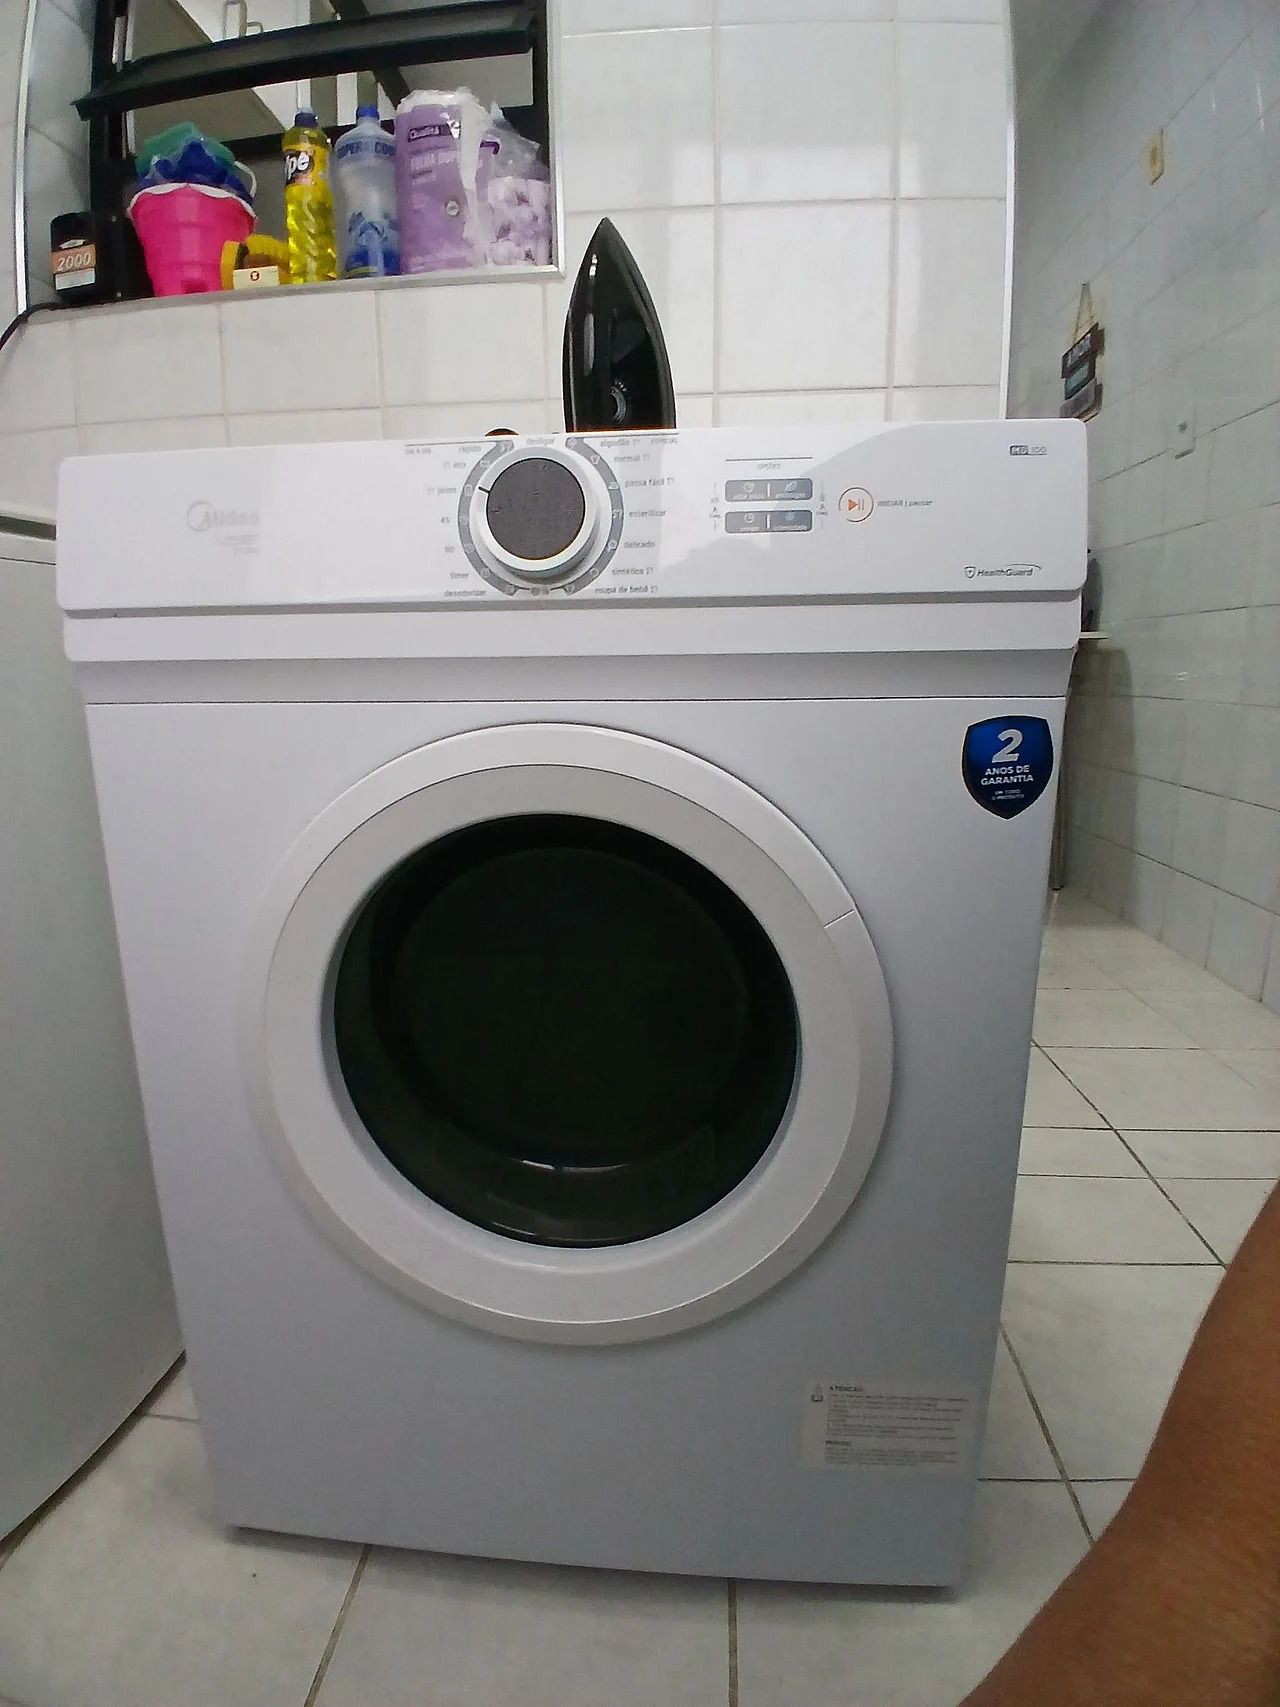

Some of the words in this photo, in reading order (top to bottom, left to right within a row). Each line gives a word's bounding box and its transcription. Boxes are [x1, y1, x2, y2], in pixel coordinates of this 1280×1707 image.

[977, 567, 1034, 577] HealthGuard
[991, 728, 1023, 764] 2
[984, 766, 1014, 776] ANOS
[1016, 764, 1030, 774] DE
[980, 774, 1034, 786] GARANTIA
